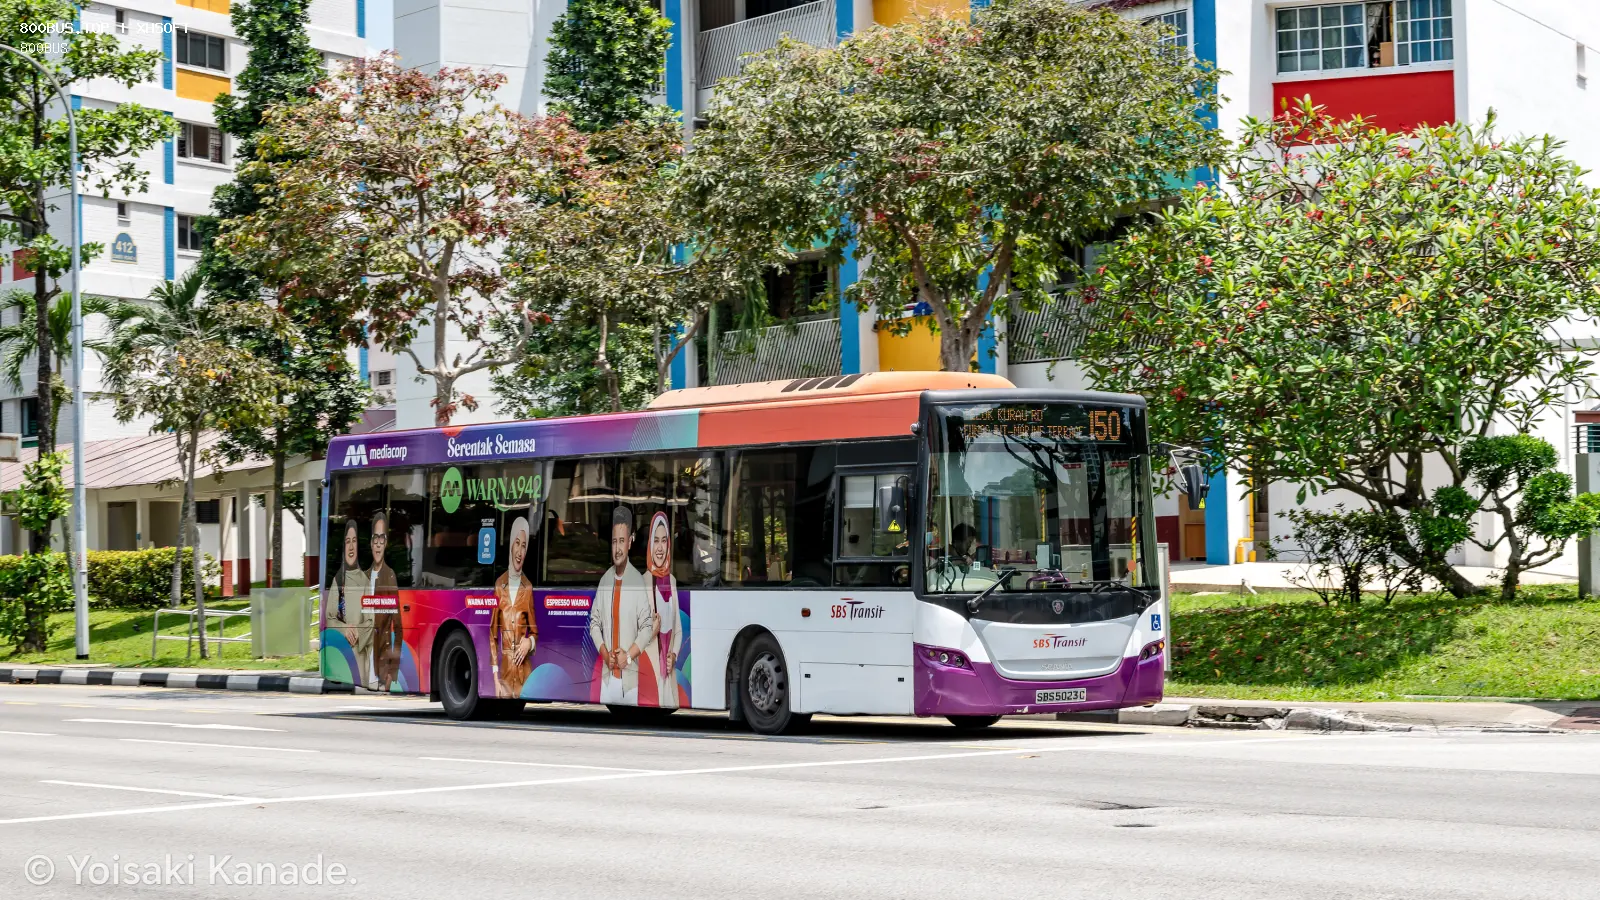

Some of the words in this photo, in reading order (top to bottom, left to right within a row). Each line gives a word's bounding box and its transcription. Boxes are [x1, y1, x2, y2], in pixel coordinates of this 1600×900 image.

[116, 241, 134, 253] 412
[997, 408, 1028, 421] KURAU
[1088, 410, 1121, 441] 150
[369, 444, 408, 461] mediacorp
[447, 437, 493, 458] Serentak
[495, 433, 536, 455] Semasa
[466, 474, 542, 511] WARNA942
[381, 598, 397, 606] WARNA
[467, 598, 484, 606] WARNA
[484, 598, 498, 606] VISTA
[546, 598, 570, 607] ESPRESSO
[571, 598, 590, 607] WARNA
[831, 605, 847, 619] SBS
[846, 601, 886, 621] Transit
[1033, 639, 1051, 649] SBS
[1049, 635, 1088, 650] Transit
[1036, 690, 1086, 702] SBS5023C
